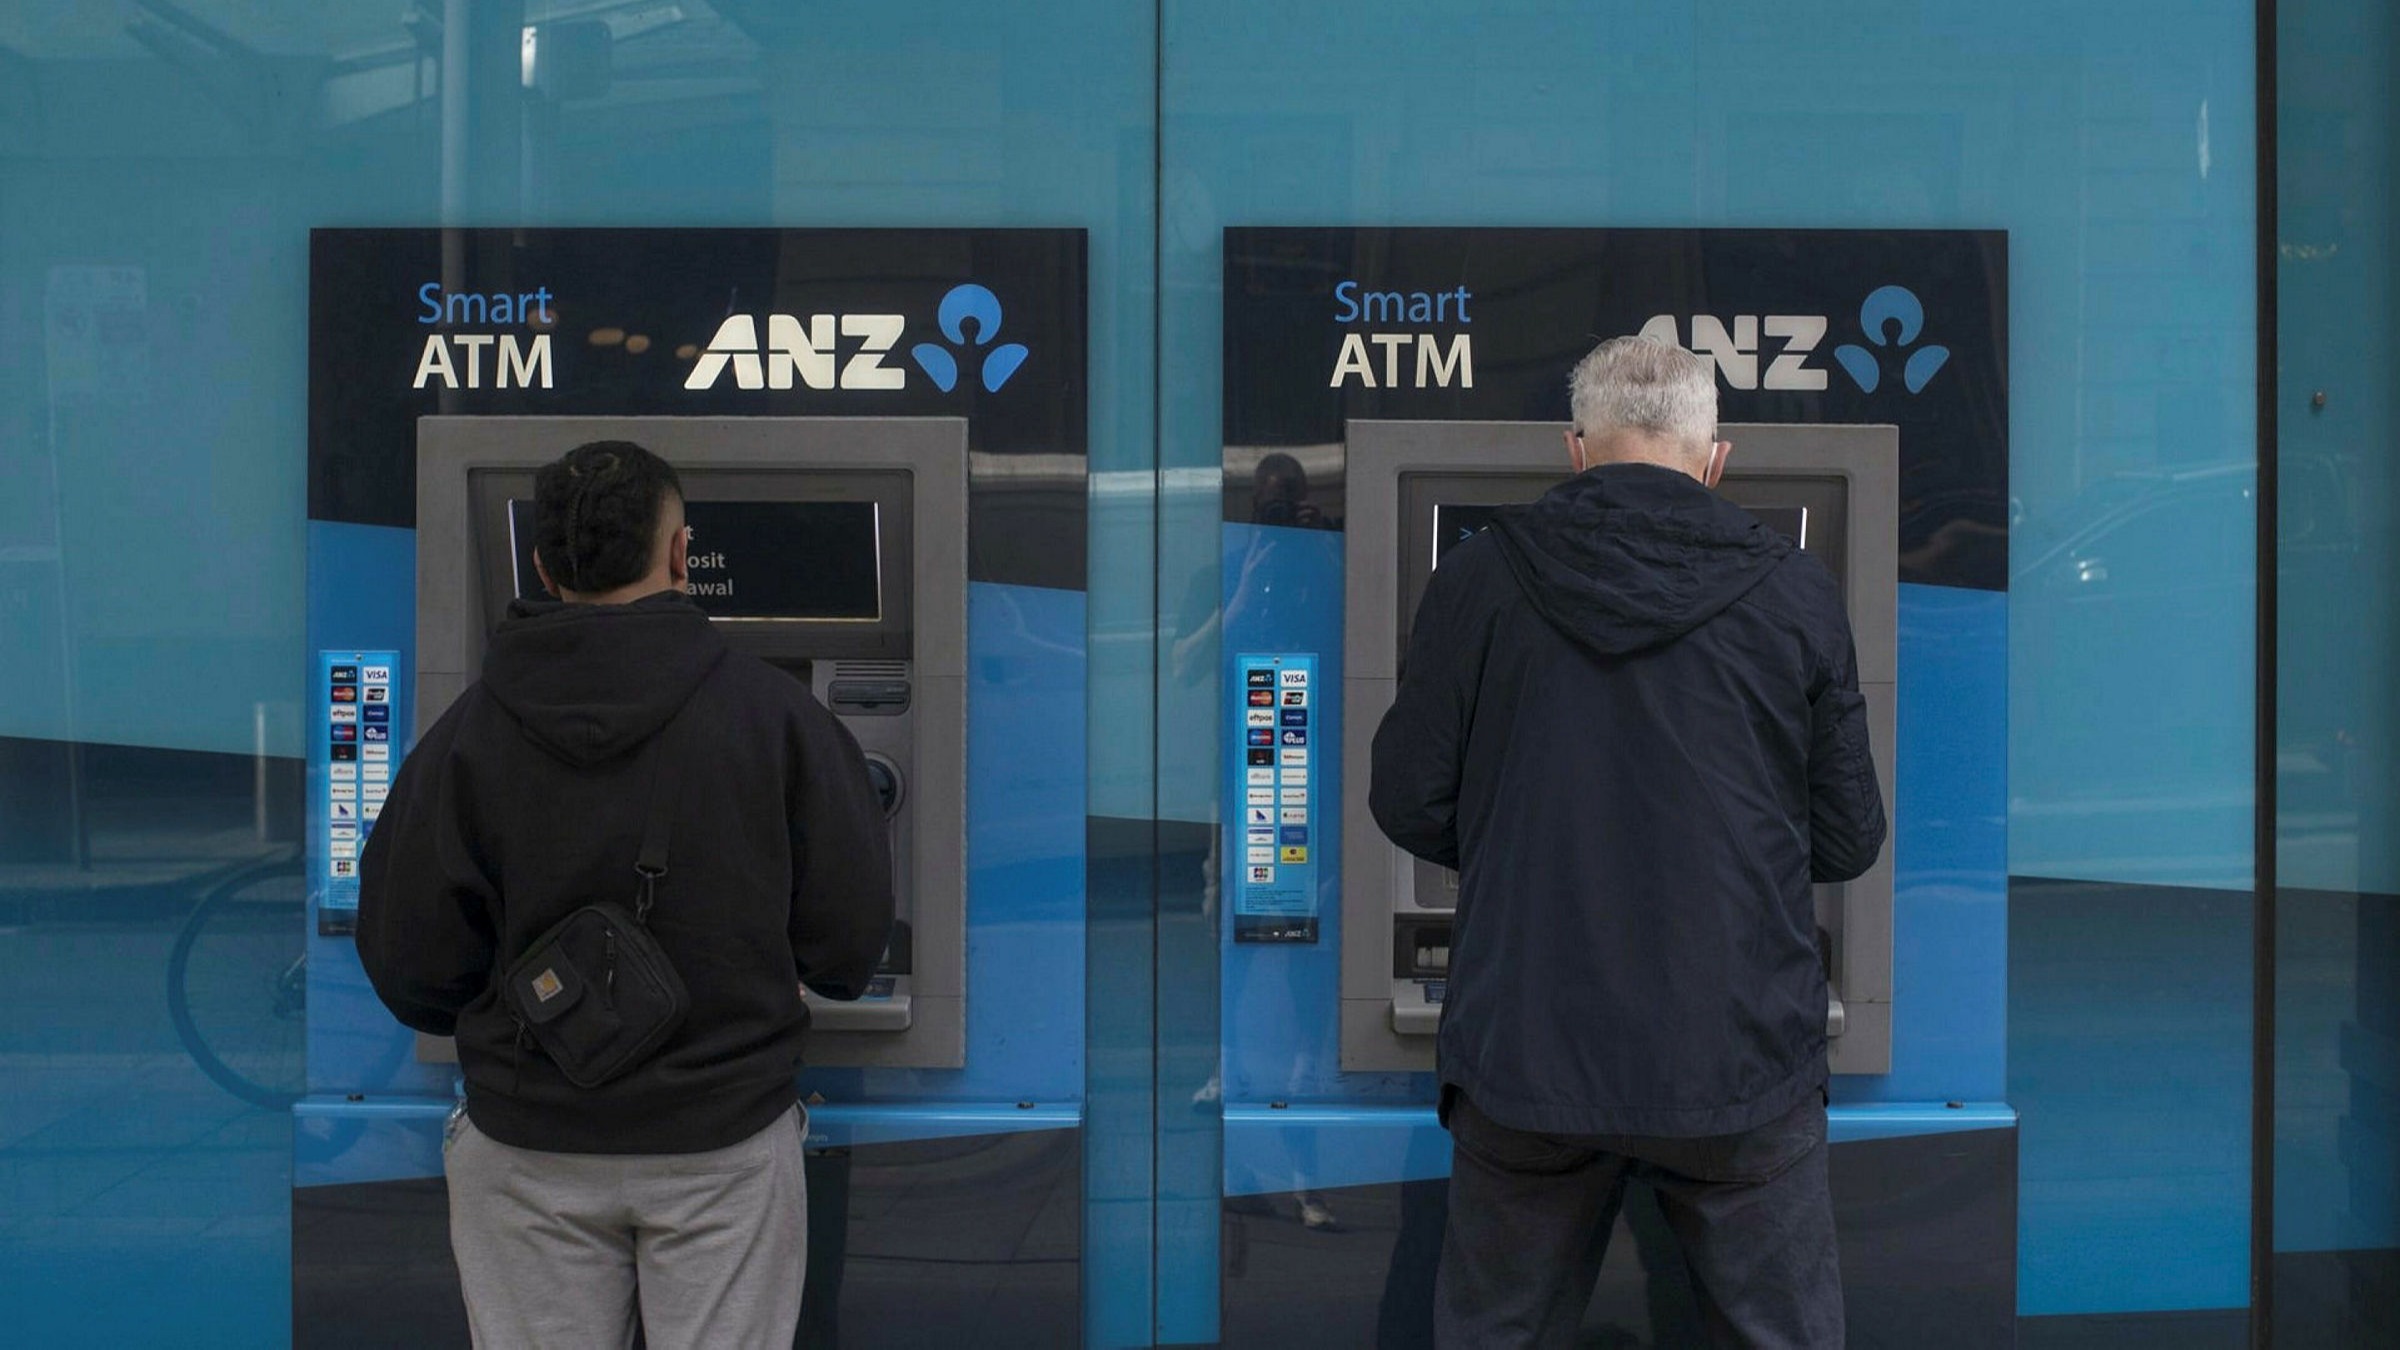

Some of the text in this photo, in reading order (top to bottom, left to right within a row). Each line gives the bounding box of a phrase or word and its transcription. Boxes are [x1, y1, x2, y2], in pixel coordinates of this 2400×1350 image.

[418, 282, 553, 324] Smart
[1334, 280, 1472, 323] Smart
[413, 334, 554, 389] ATM
[684, 314, 906, 390] ANZ
[1330, 333, 1473, 389] ATM
[687, 551, 726, 569] osit
[366, 671, 388, 680] VISA
[1284, 674, 1306, 683] VISA
[1249, 714, 1272, 722] eftpos
